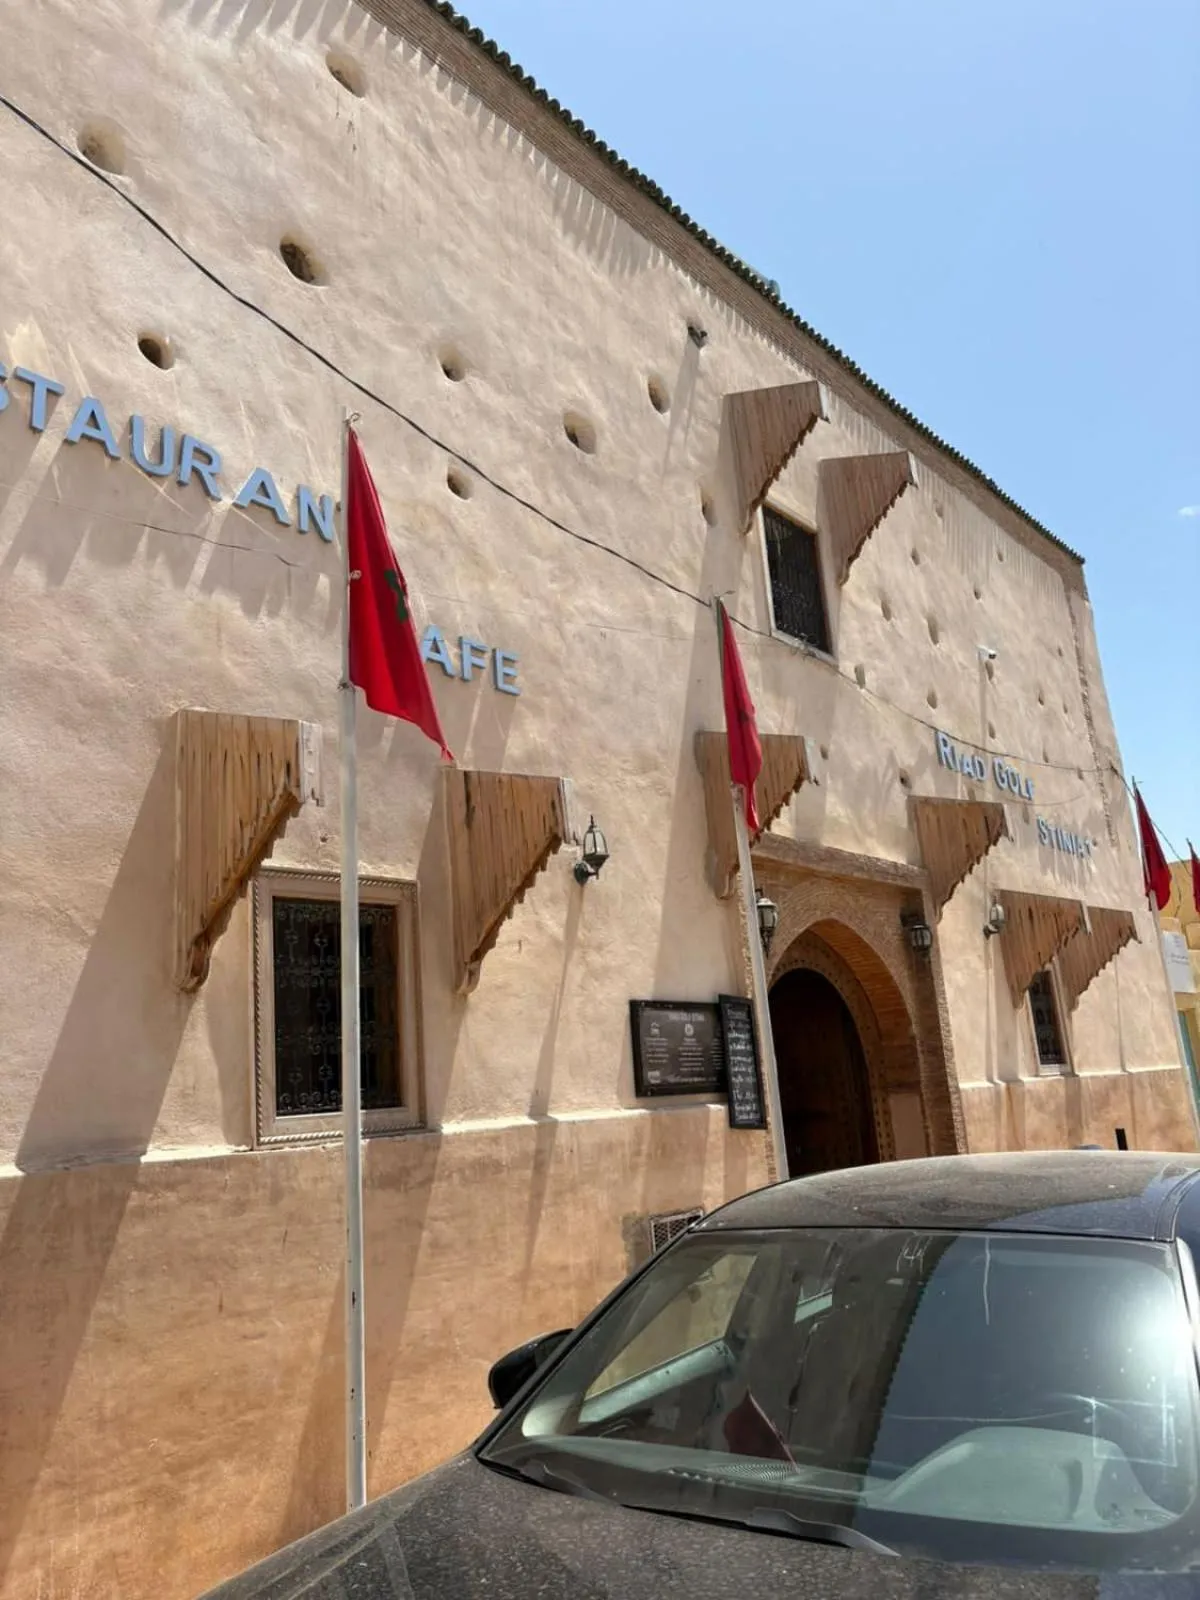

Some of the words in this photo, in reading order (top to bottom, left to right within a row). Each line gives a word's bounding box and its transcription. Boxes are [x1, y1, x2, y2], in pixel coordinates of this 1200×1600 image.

[0, 362, 336, 543] TAURAN
[421, 623, 523, 696] AFE
[935, 730, 986, 782] RIAD
